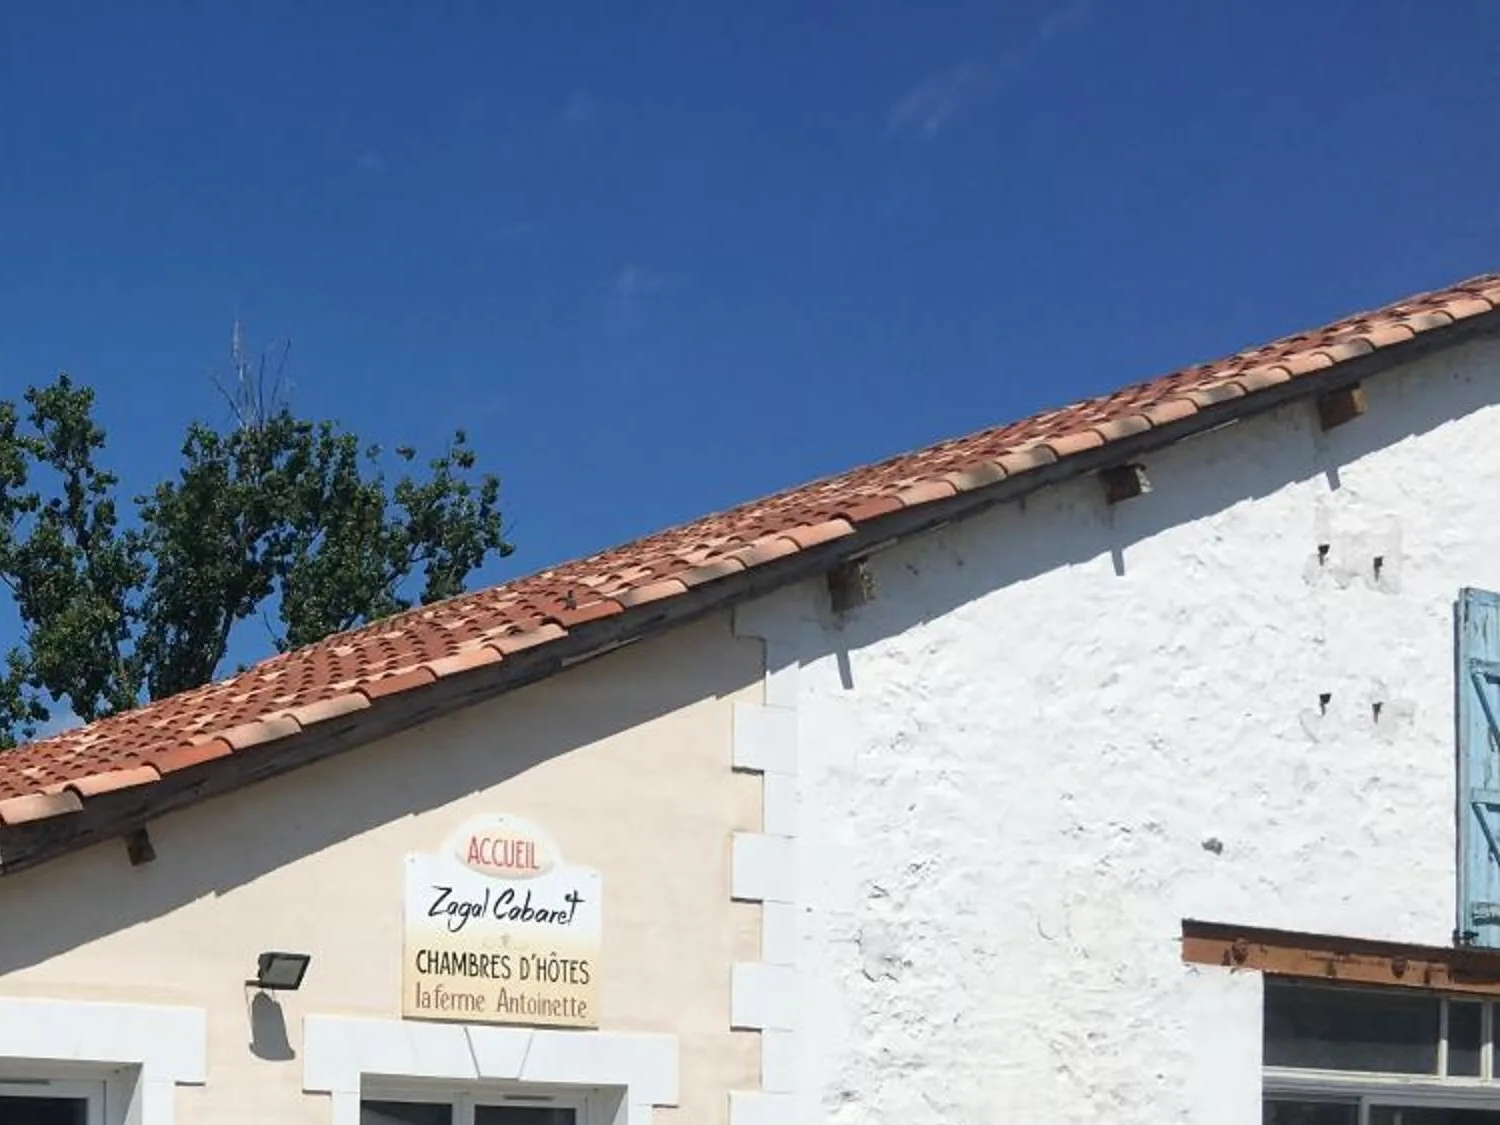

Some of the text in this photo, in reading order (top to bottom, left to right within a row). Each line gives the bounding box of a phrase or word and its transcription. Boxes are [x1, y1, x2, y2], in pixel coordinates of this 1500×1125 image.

[467, 836, 540, 870] ACCUEIL
[493, 887, 585, 926] Cabaret
[416, 949, 590, 984] CHAMBRES D'HÔTES
[496, 987, 587, 1018] Antoinette
